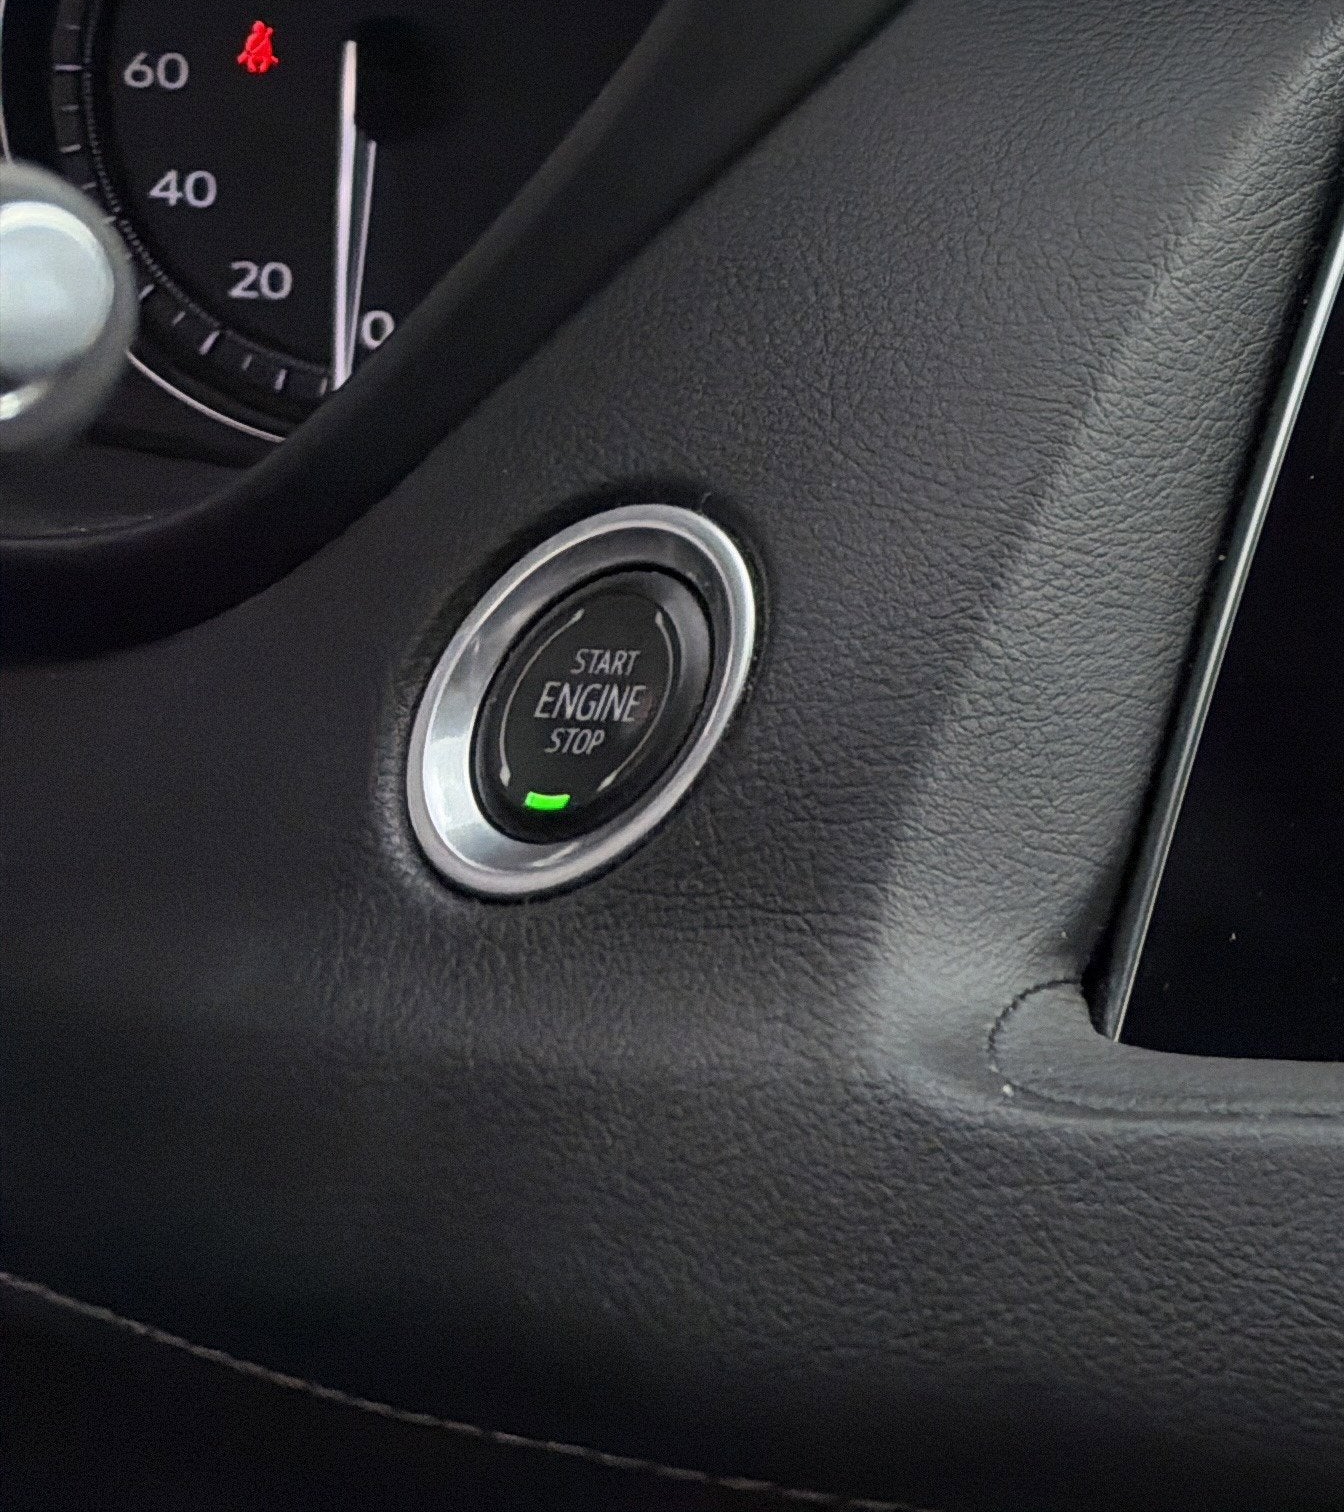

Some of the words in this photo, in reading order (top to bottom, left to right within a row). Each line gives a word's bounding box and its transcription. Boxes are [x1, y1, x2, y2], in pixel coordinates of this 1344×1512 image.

[125, 52, 189, 90] 60
[149, 170, 216, 208] 40
[230, 262, 291, 300] 20
[364, 311, 393, 348] 0
[570, 649, 641, 675] START
[534, 681, 646, 722] ENGINE
[544, 728, 604, 754] STOP
